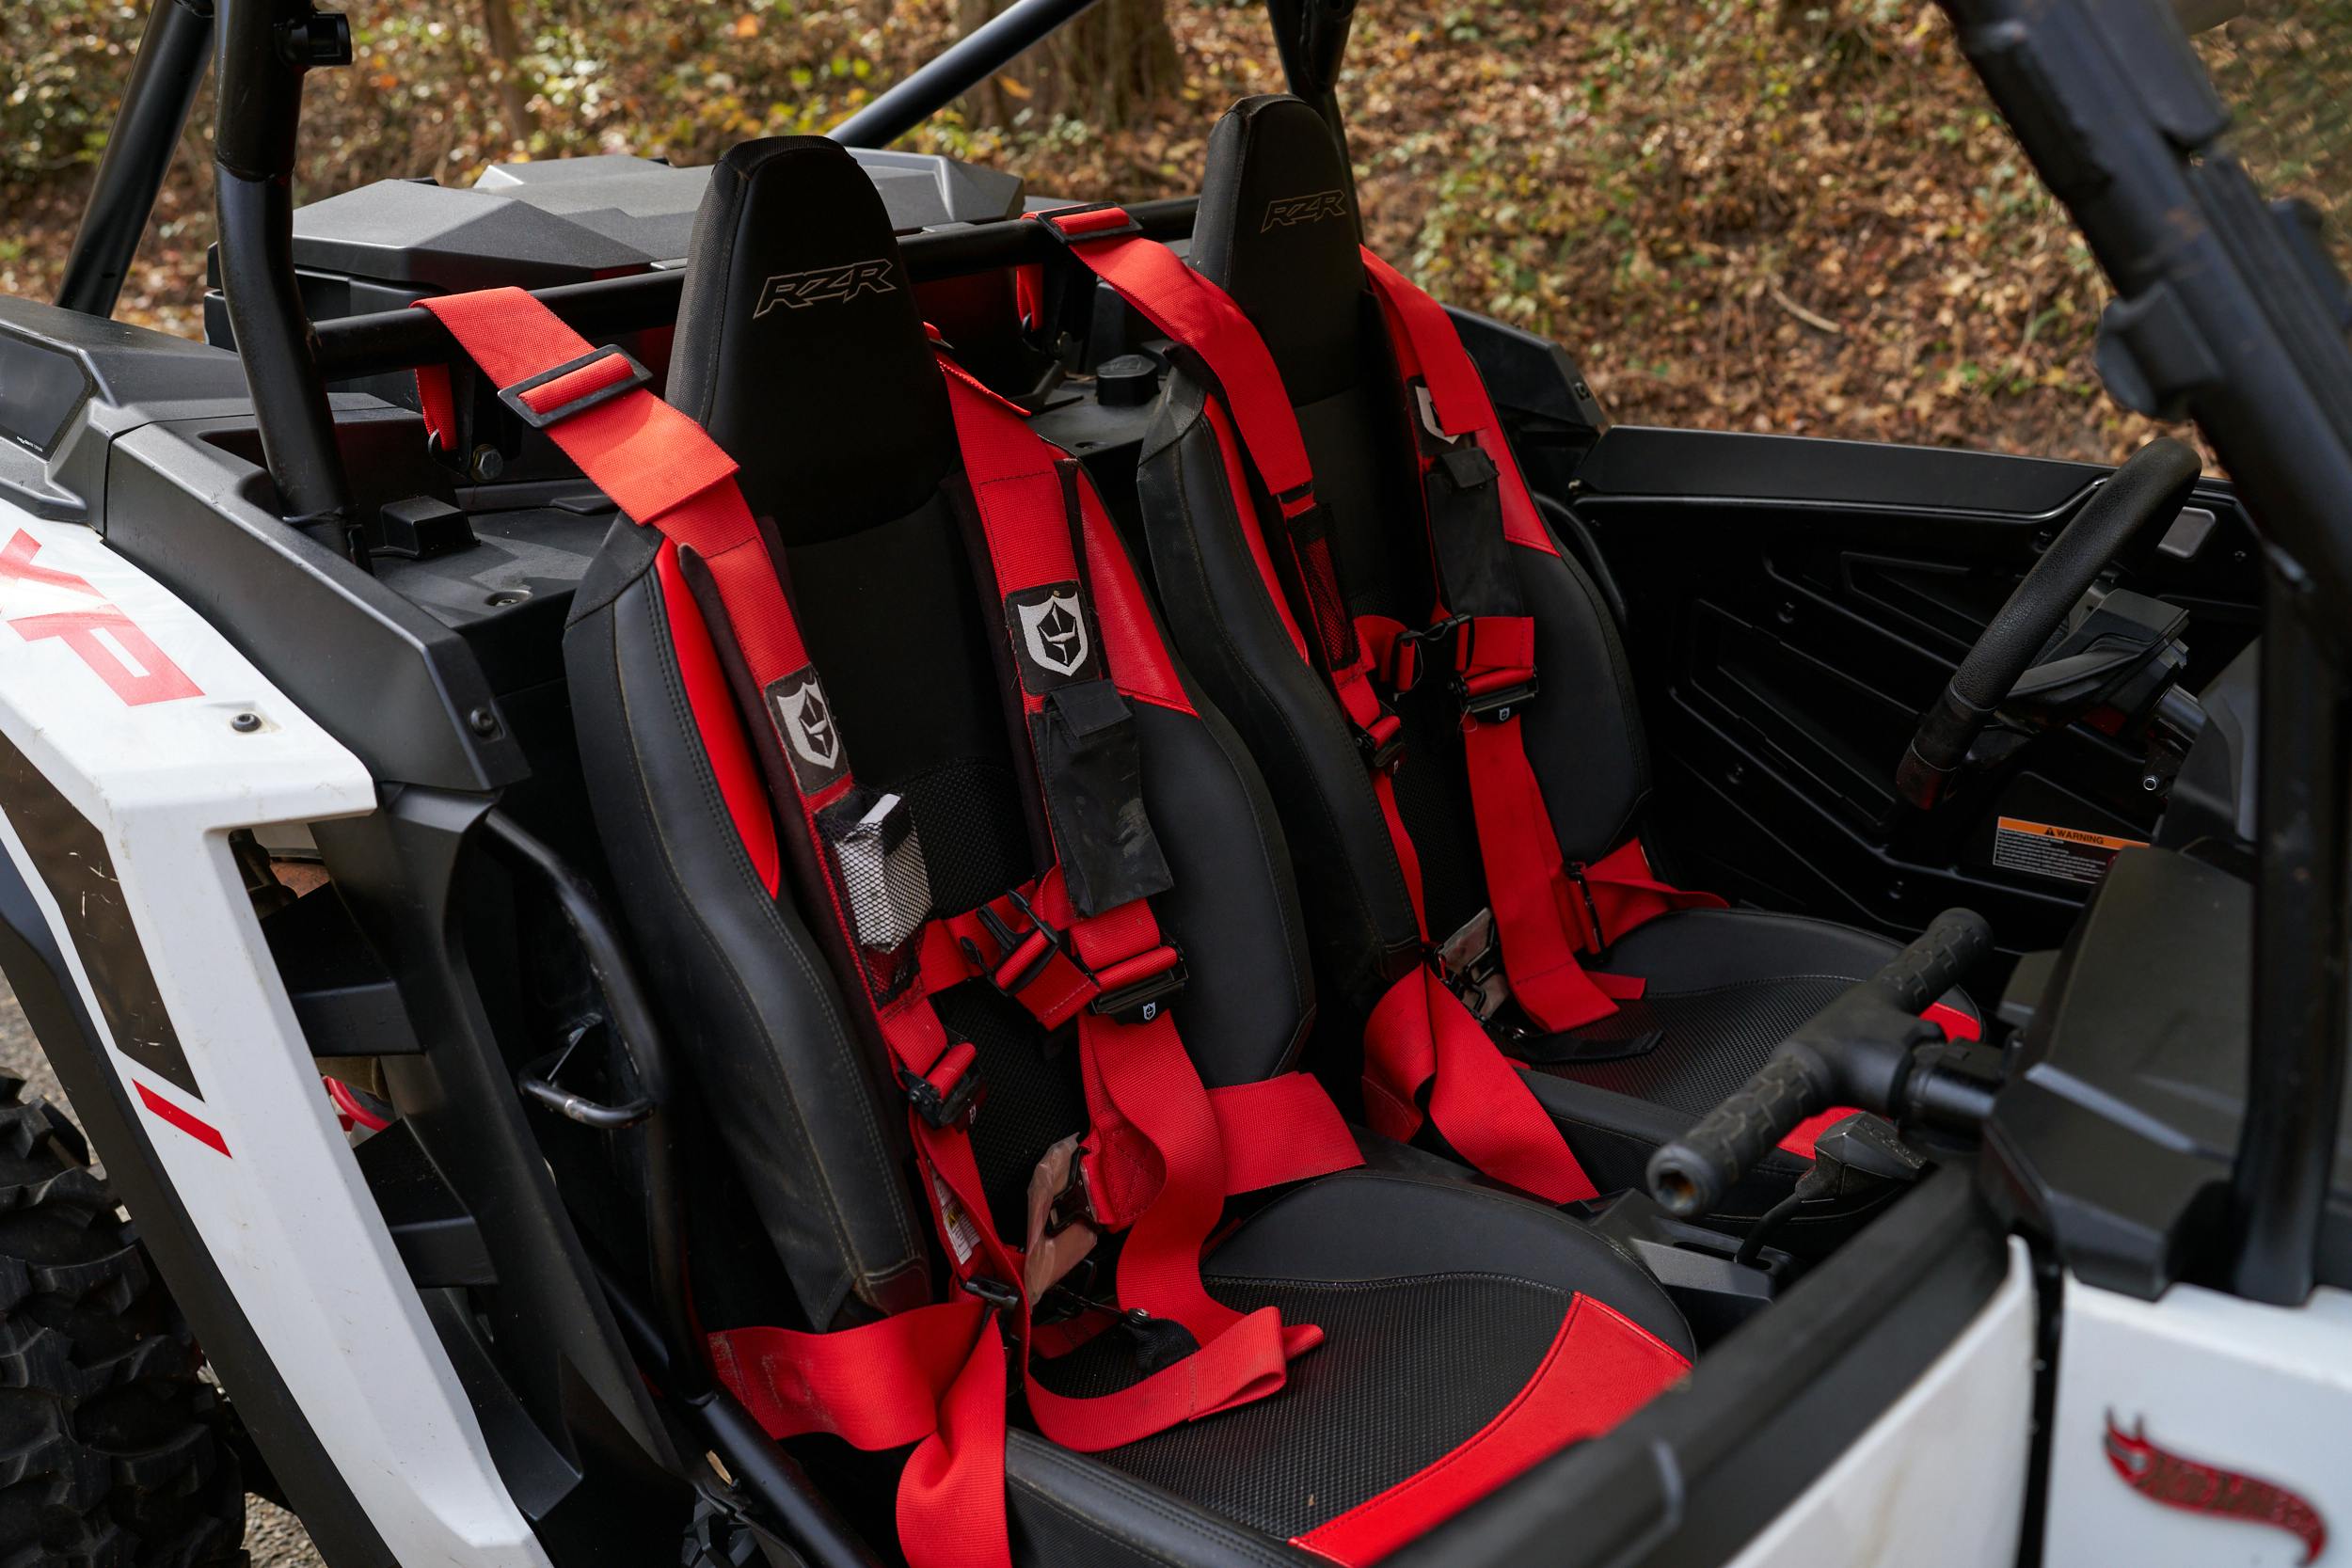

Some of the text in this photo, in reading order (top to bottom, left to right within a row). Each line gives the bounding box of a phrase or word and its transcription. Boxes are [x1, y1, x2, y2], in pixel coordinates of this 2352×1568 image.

[1261, 189, 1346, 233] RZR
[753, 259, 897, 319] RZR
[2056, 829, 2105, 846] WARNING
